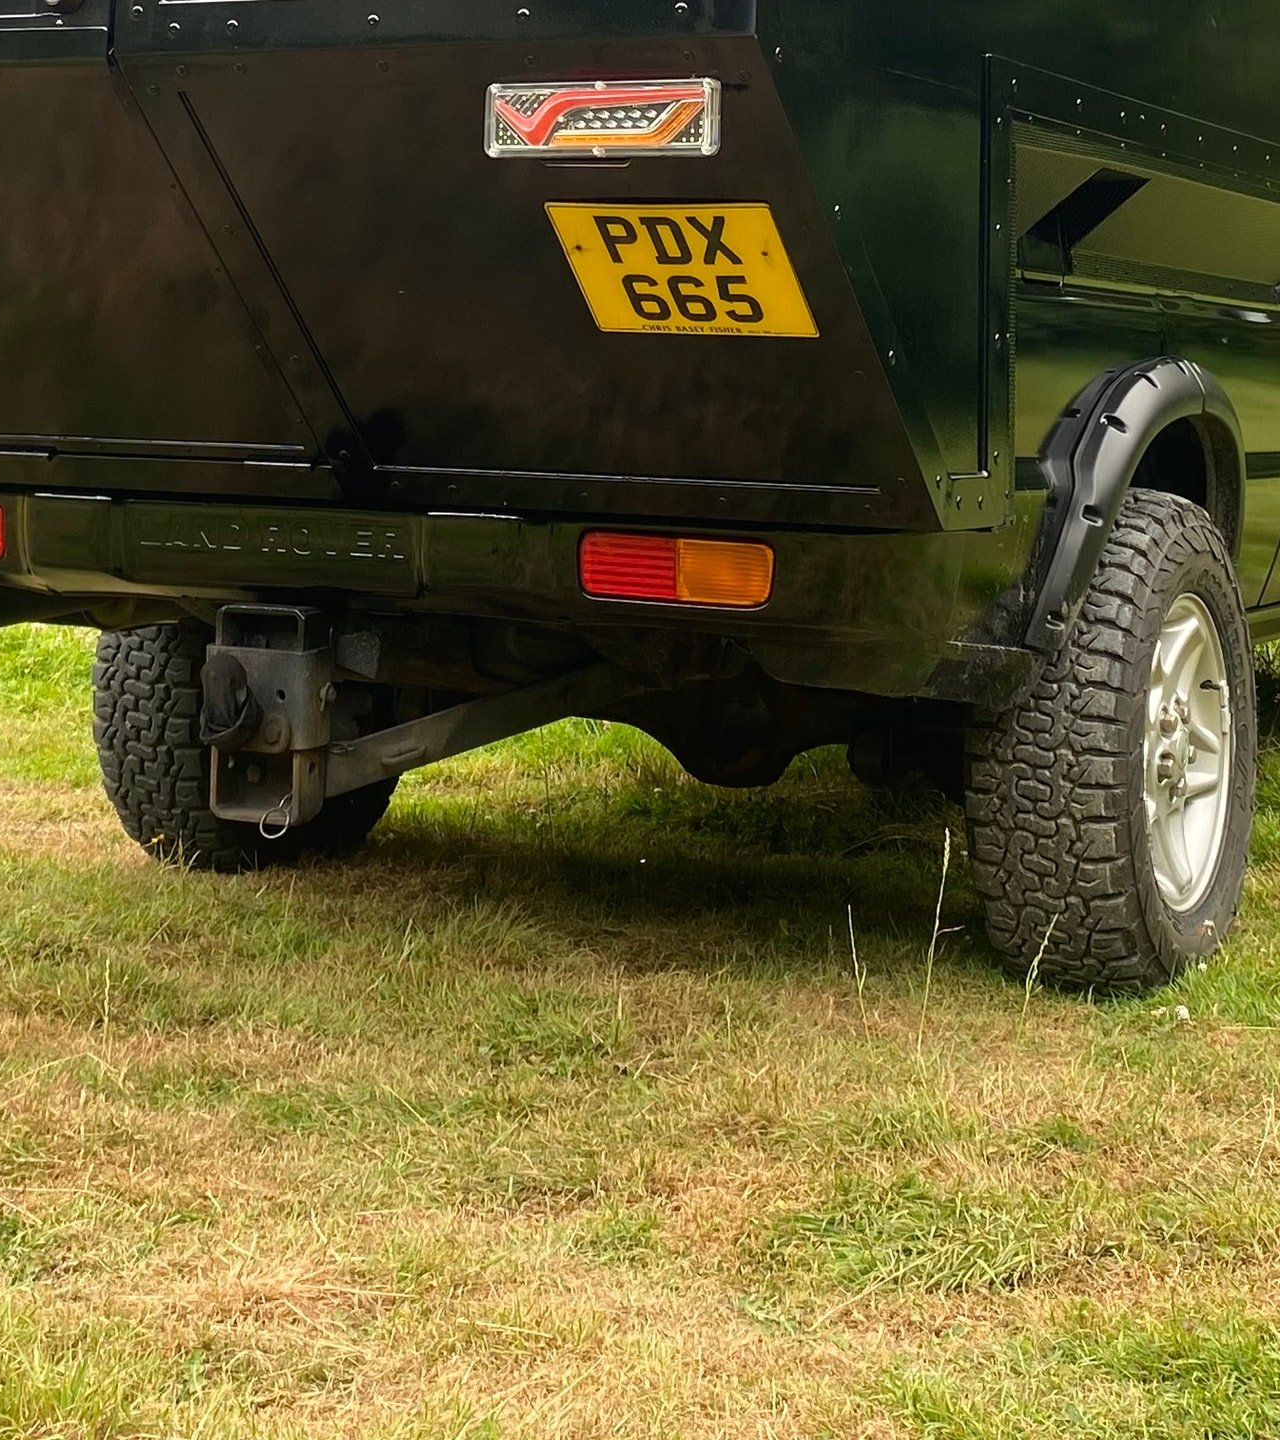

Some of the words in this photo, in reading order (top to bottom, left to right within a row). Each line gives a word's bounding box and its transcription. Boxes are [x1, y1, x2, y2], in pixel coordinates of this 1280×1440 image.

[593, 215, 743, 265] PDX
[621, 274, 764, 323] 665
[642, 324, 673, 332] CHRIS
[138, 515, 250, 550] LAND
[260, 517, 406, 559] ROVER
